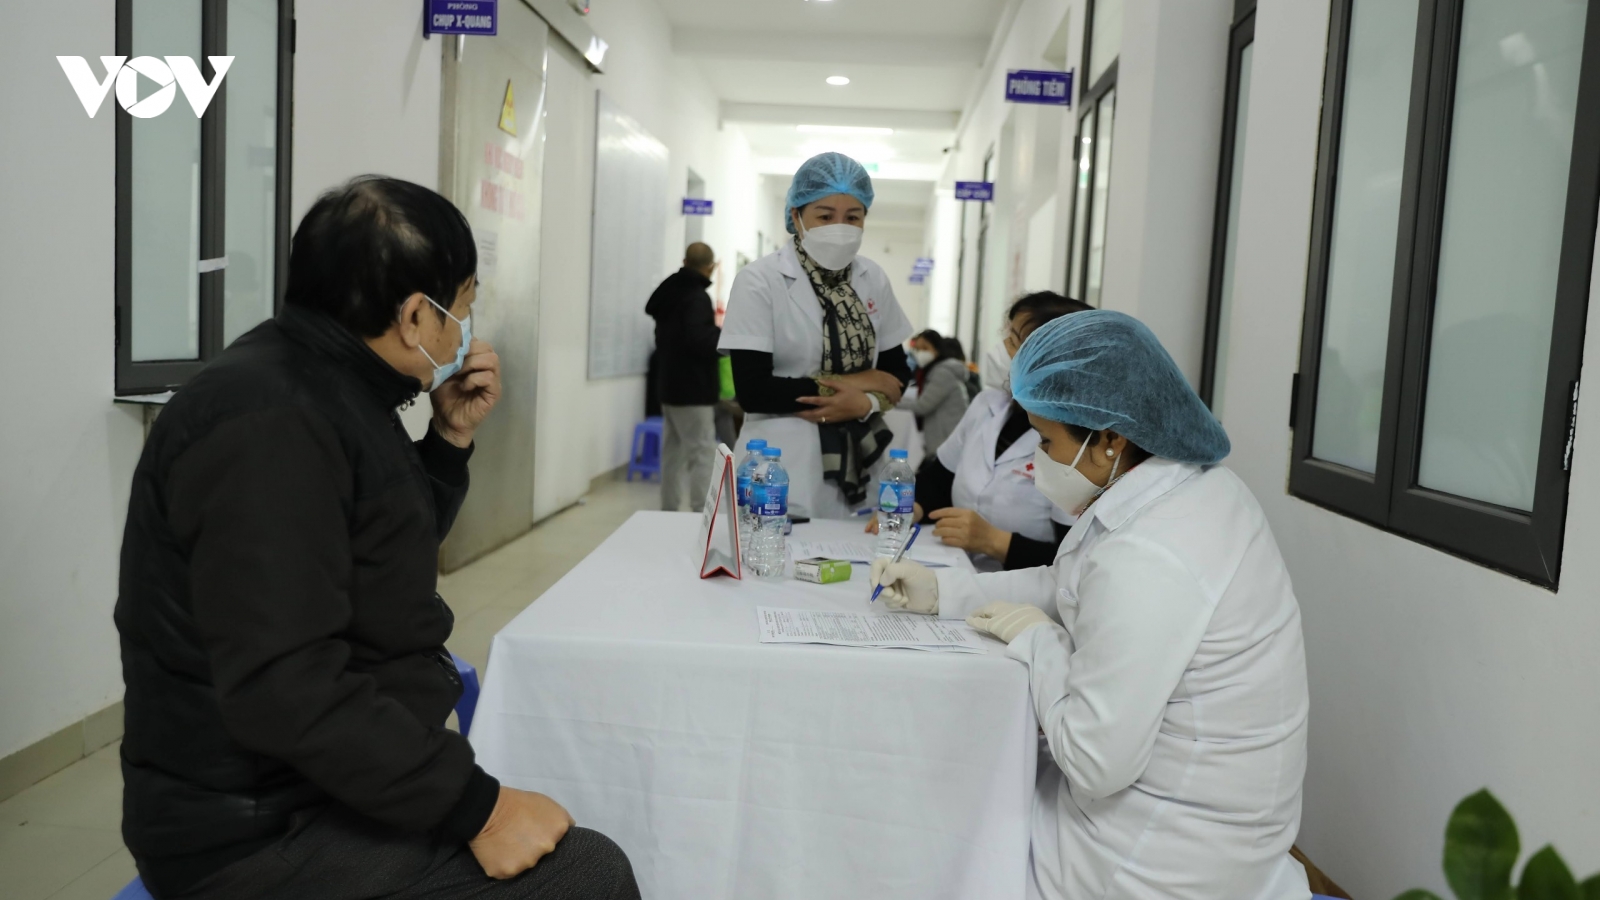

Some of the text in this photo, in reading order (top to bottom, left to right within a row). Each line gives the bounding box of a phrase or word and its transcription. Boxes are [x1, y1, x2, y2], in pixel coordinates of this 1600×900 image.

[433, 14, 492, 30] CHỤP X-QUANG
[1009, 76, 1066, 97] PHÒNG TIÊM
